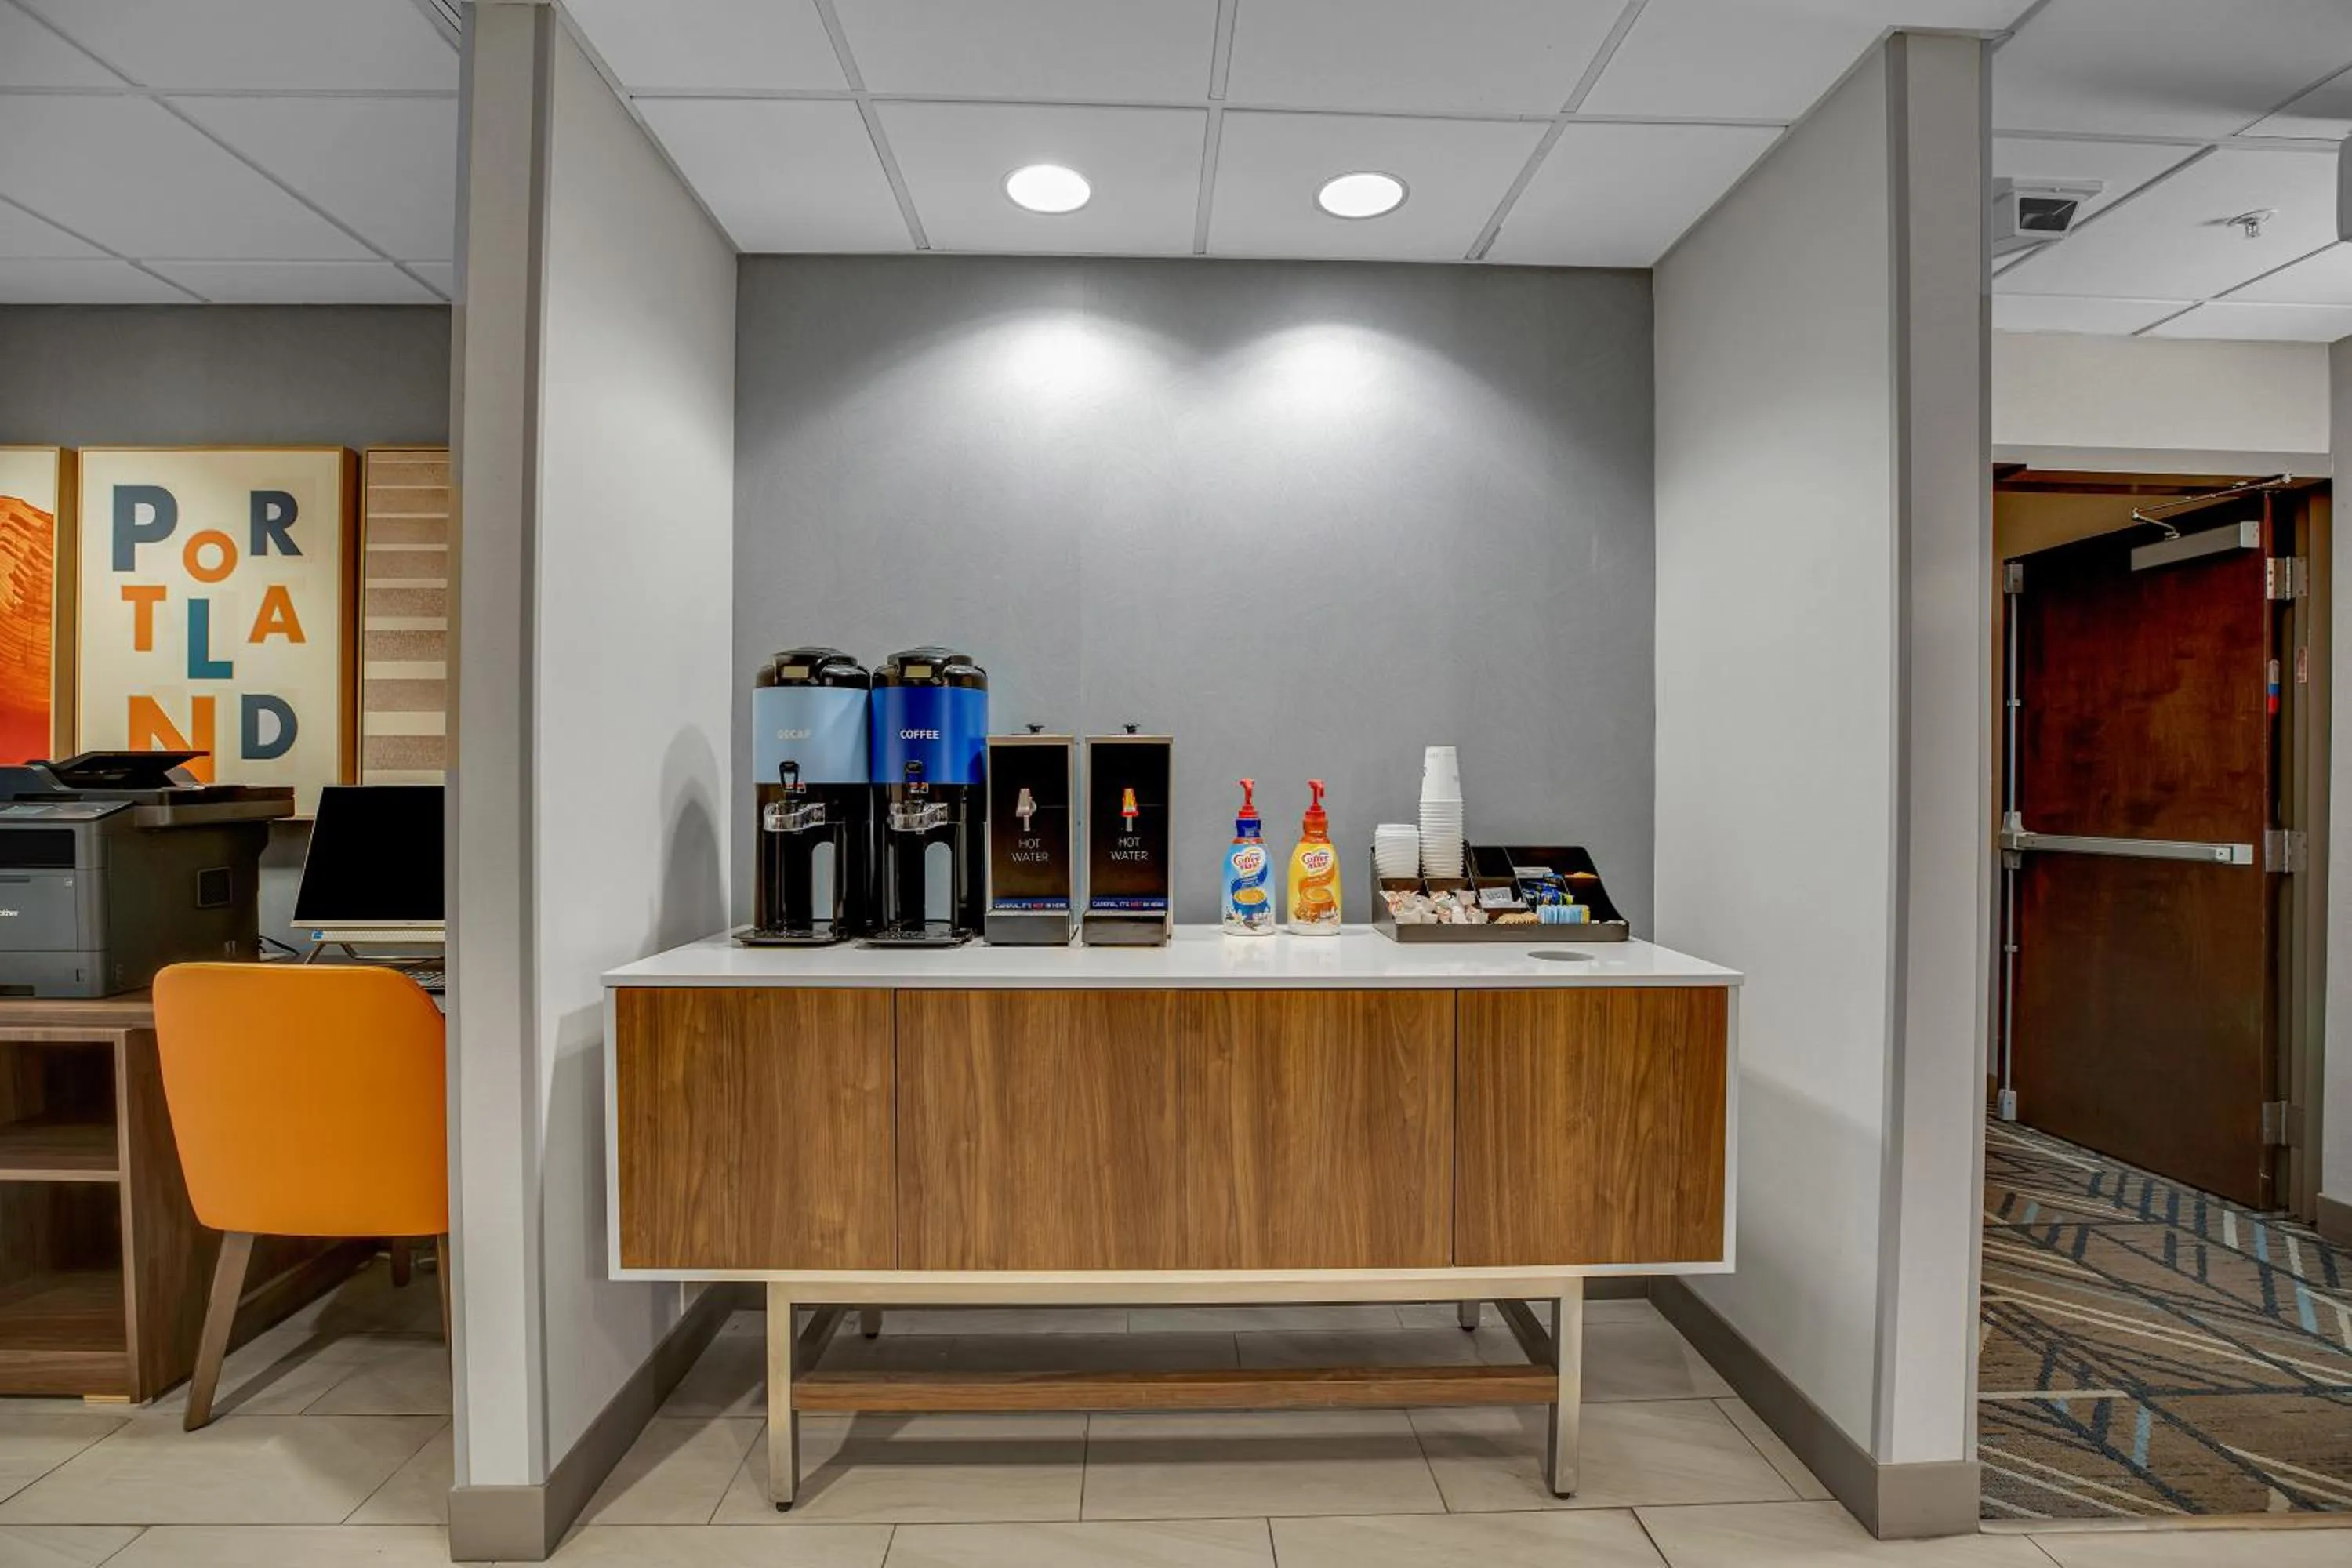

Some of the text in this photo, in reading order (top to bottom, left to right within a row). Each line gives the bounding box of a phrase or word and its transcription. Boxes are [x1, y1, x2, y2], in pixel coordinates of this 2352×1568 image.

[777, 729, 811, 739] DECAF
[900, 730, 940, 739] COFFEE
[1018, 838, 1041, 849] HOT
[1118, 837, 1141, 848] HOT
[1011, 852, 1049, 862] WATER
[1109, 851, 1149, 861] WATER
